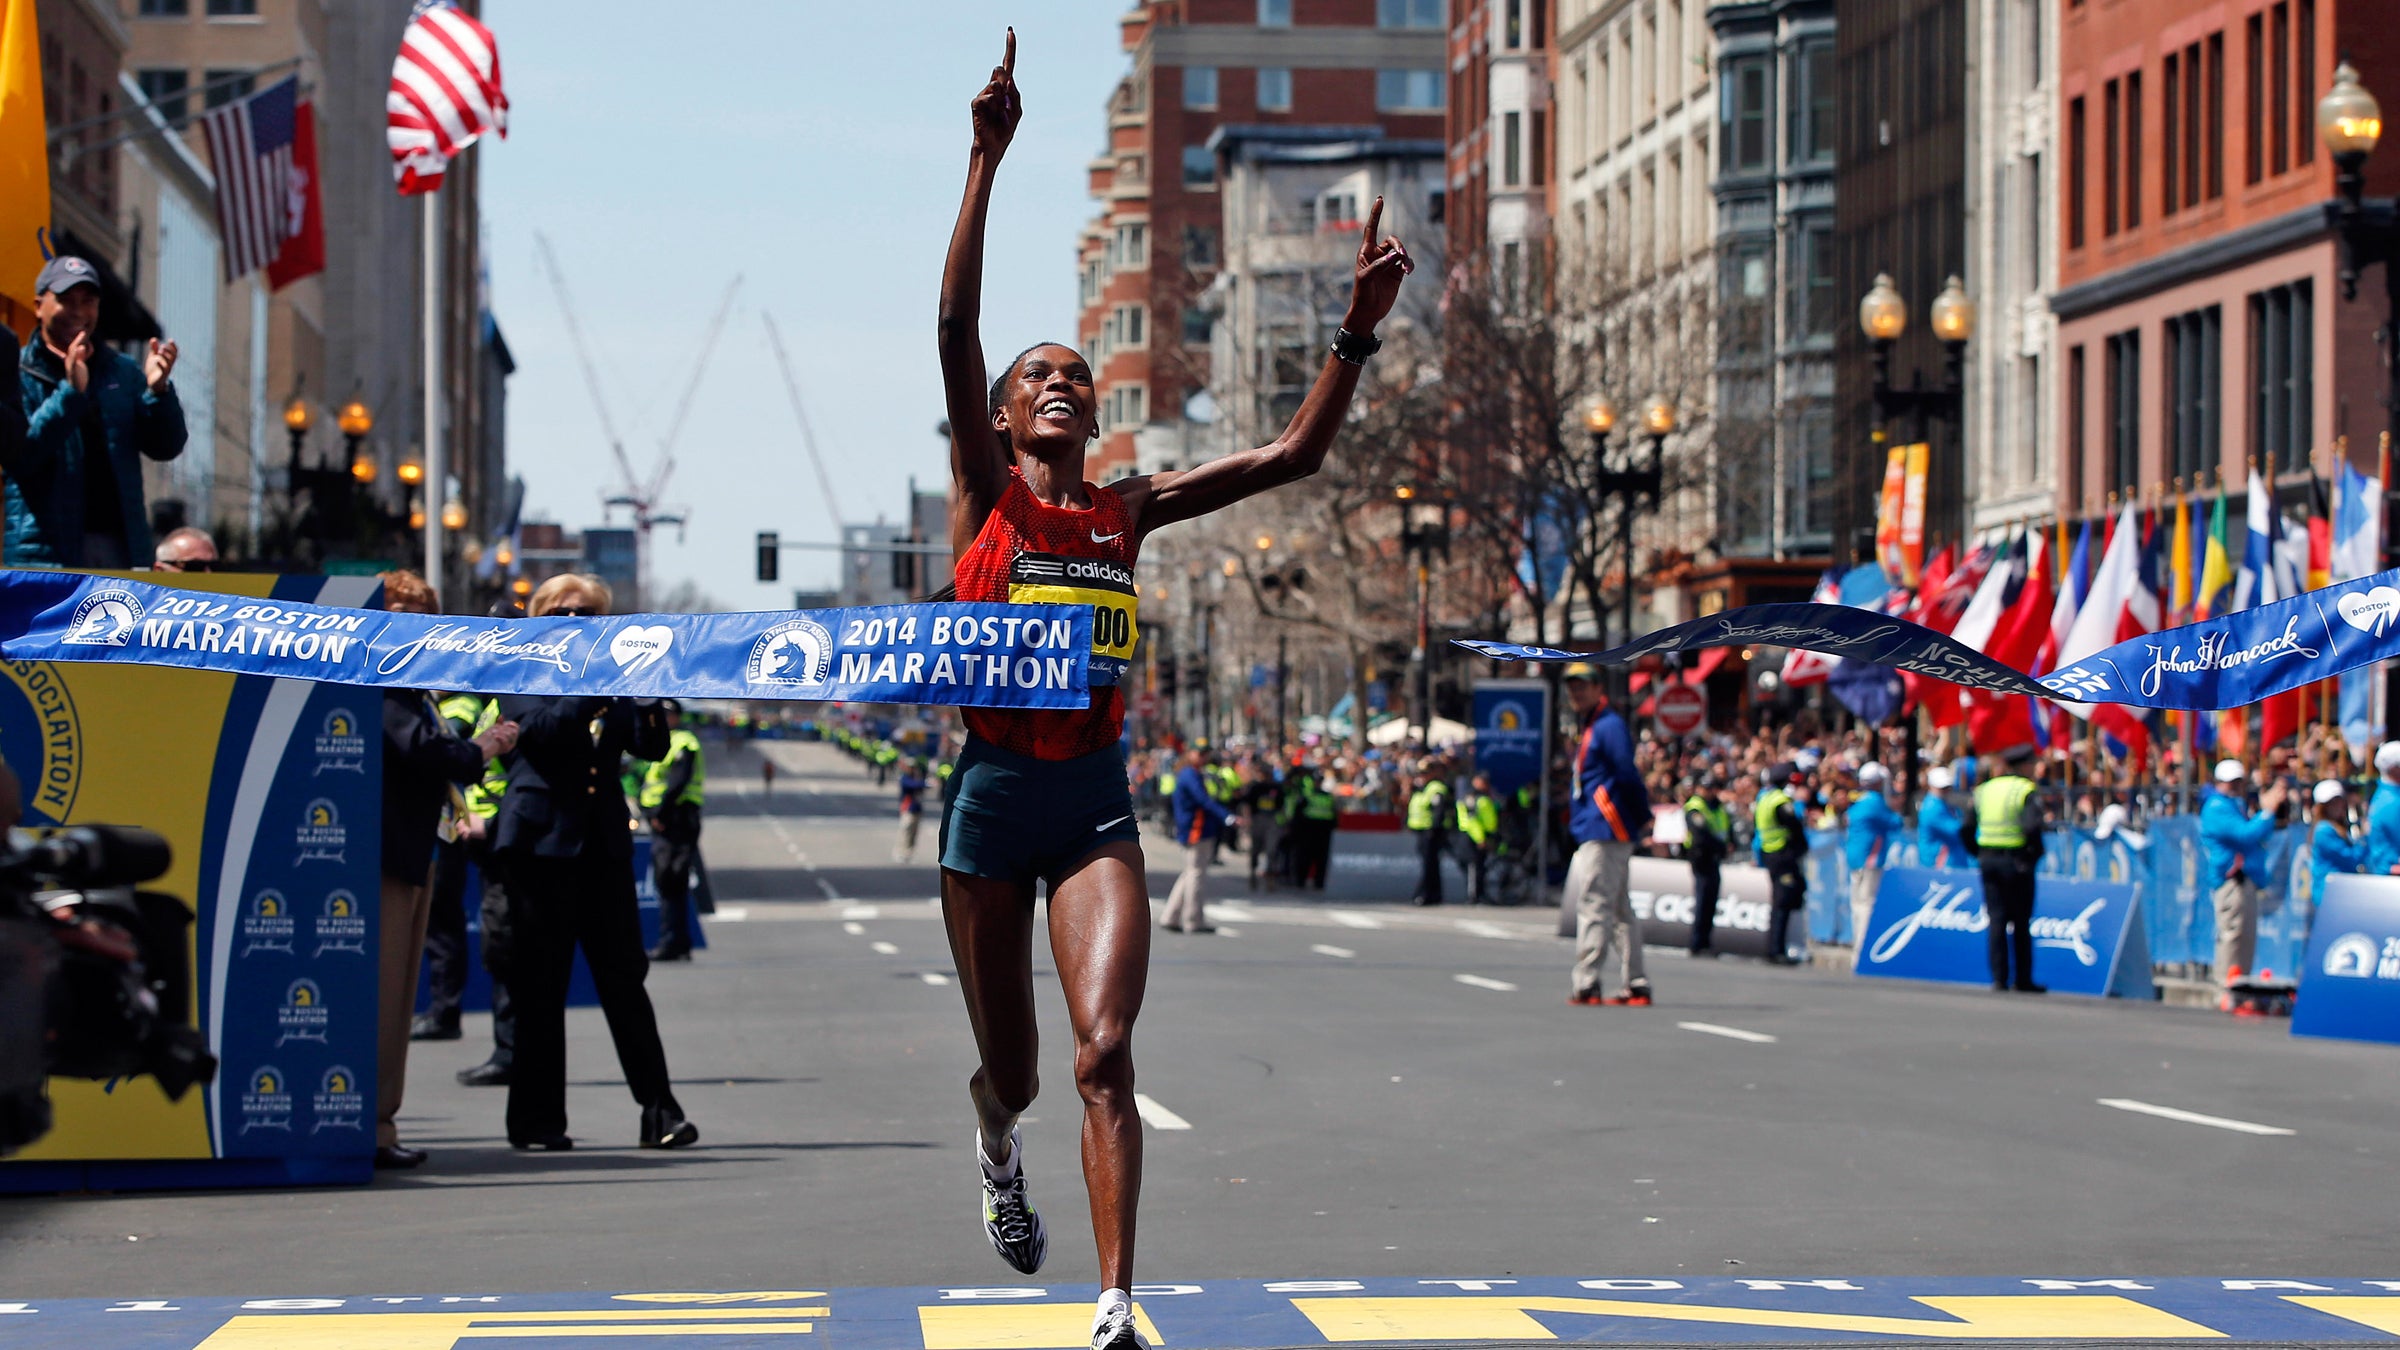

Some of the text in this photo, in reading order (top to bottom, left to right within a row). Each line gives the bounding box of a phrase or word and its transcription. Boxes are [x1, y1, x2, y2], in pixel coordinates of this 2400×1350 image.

[1067, 562, 1131, 586] adidas
[84, 592, 123, 612] ATHLETIC
[152, 597, 367, 632] 2014 BOSTON
[2352, 601, 2391, 617] BOSTON
[377, 623, 583, 675] John Hancock
[620, 640, 659, 649] BOSTON
[844, 616, 918, 646] 2014
[931, 615, 1072, 650] BOSTON
[750, 623, 830, 680] BOSTON ATHLETIC ASSOCIATION
[2139, 643, 2199, 697] John
[2196, 614, 2320, 671] Hancock
[3, 660, 73, 807] SOCIATION
[937, 1279, 1864, 1299] BOSTON
